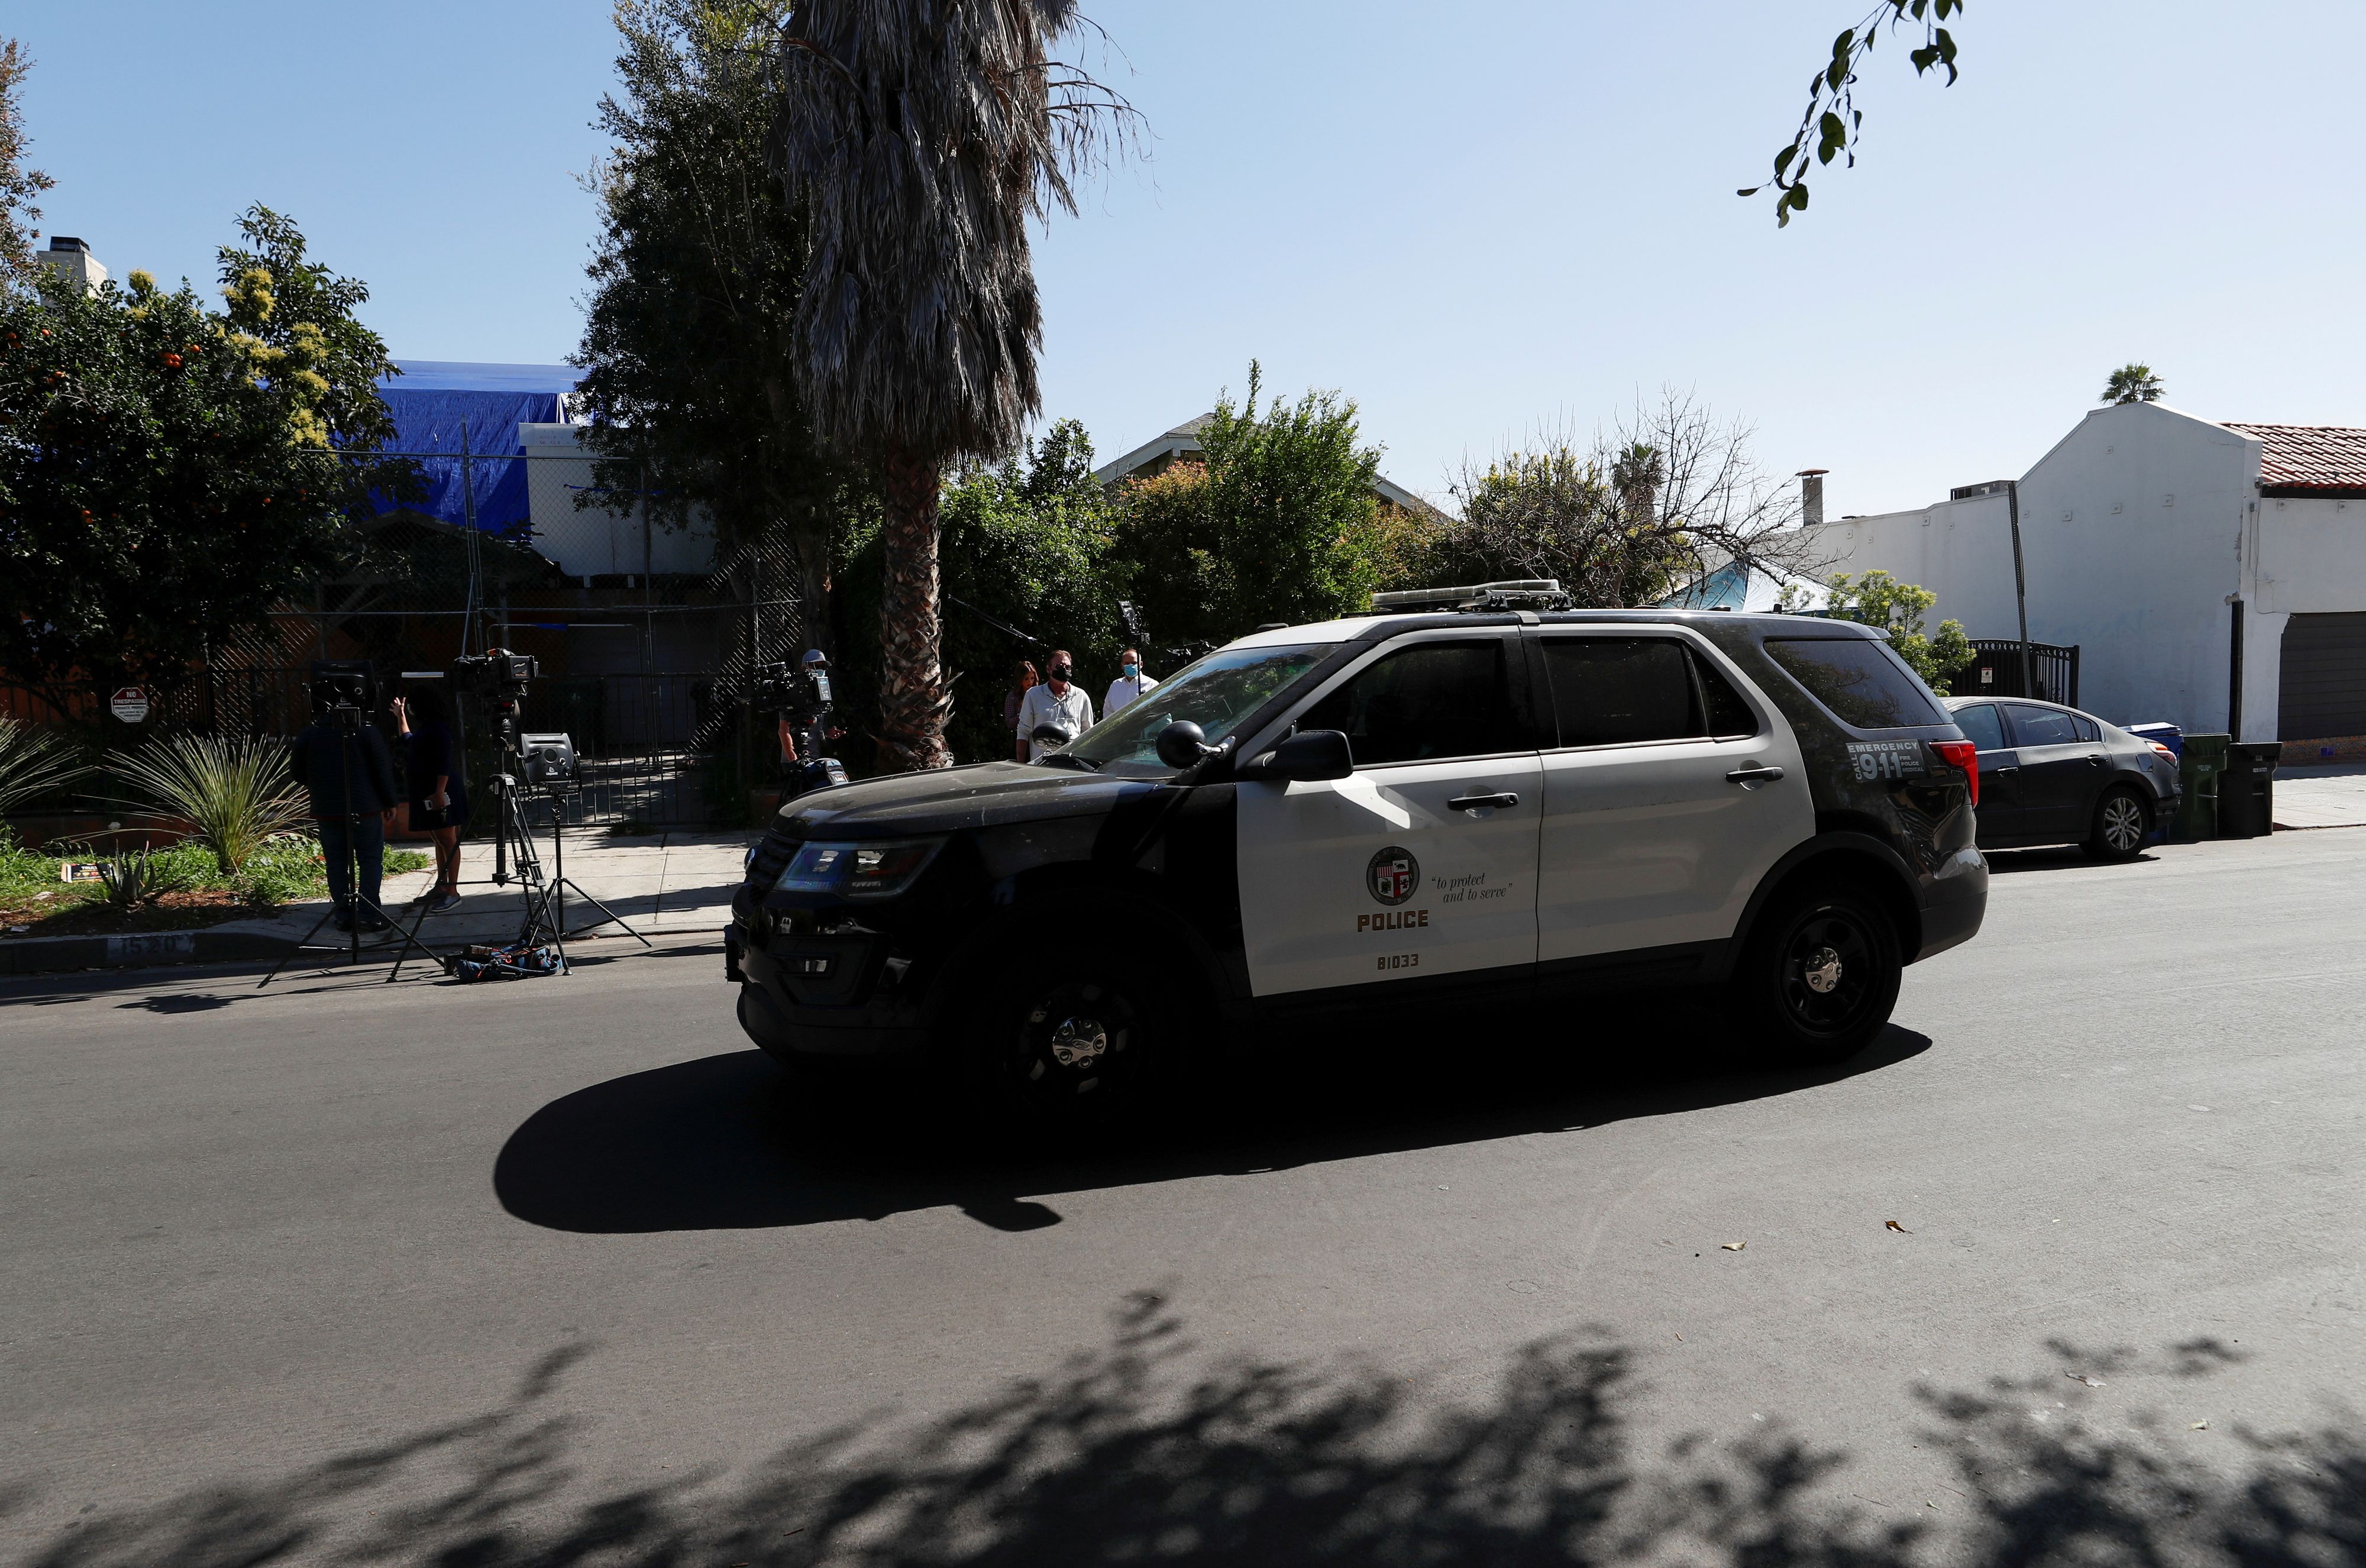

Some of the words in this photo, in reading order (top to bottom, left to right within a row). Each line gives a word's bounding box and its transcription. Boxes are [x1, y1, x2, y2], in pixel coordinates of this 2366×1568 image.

[1847, 742, 1918, 753] EMERGENCY
[1851, 754, 1862, 780] CALL
[1449, 872, 1485, 891] protect
[1443, 888, 1464, 903] and
[1468, 889, 1477, 900] to
[1357, 910, 1428, 932] POLICE
[1379, 954, 1418, 970] 81033
